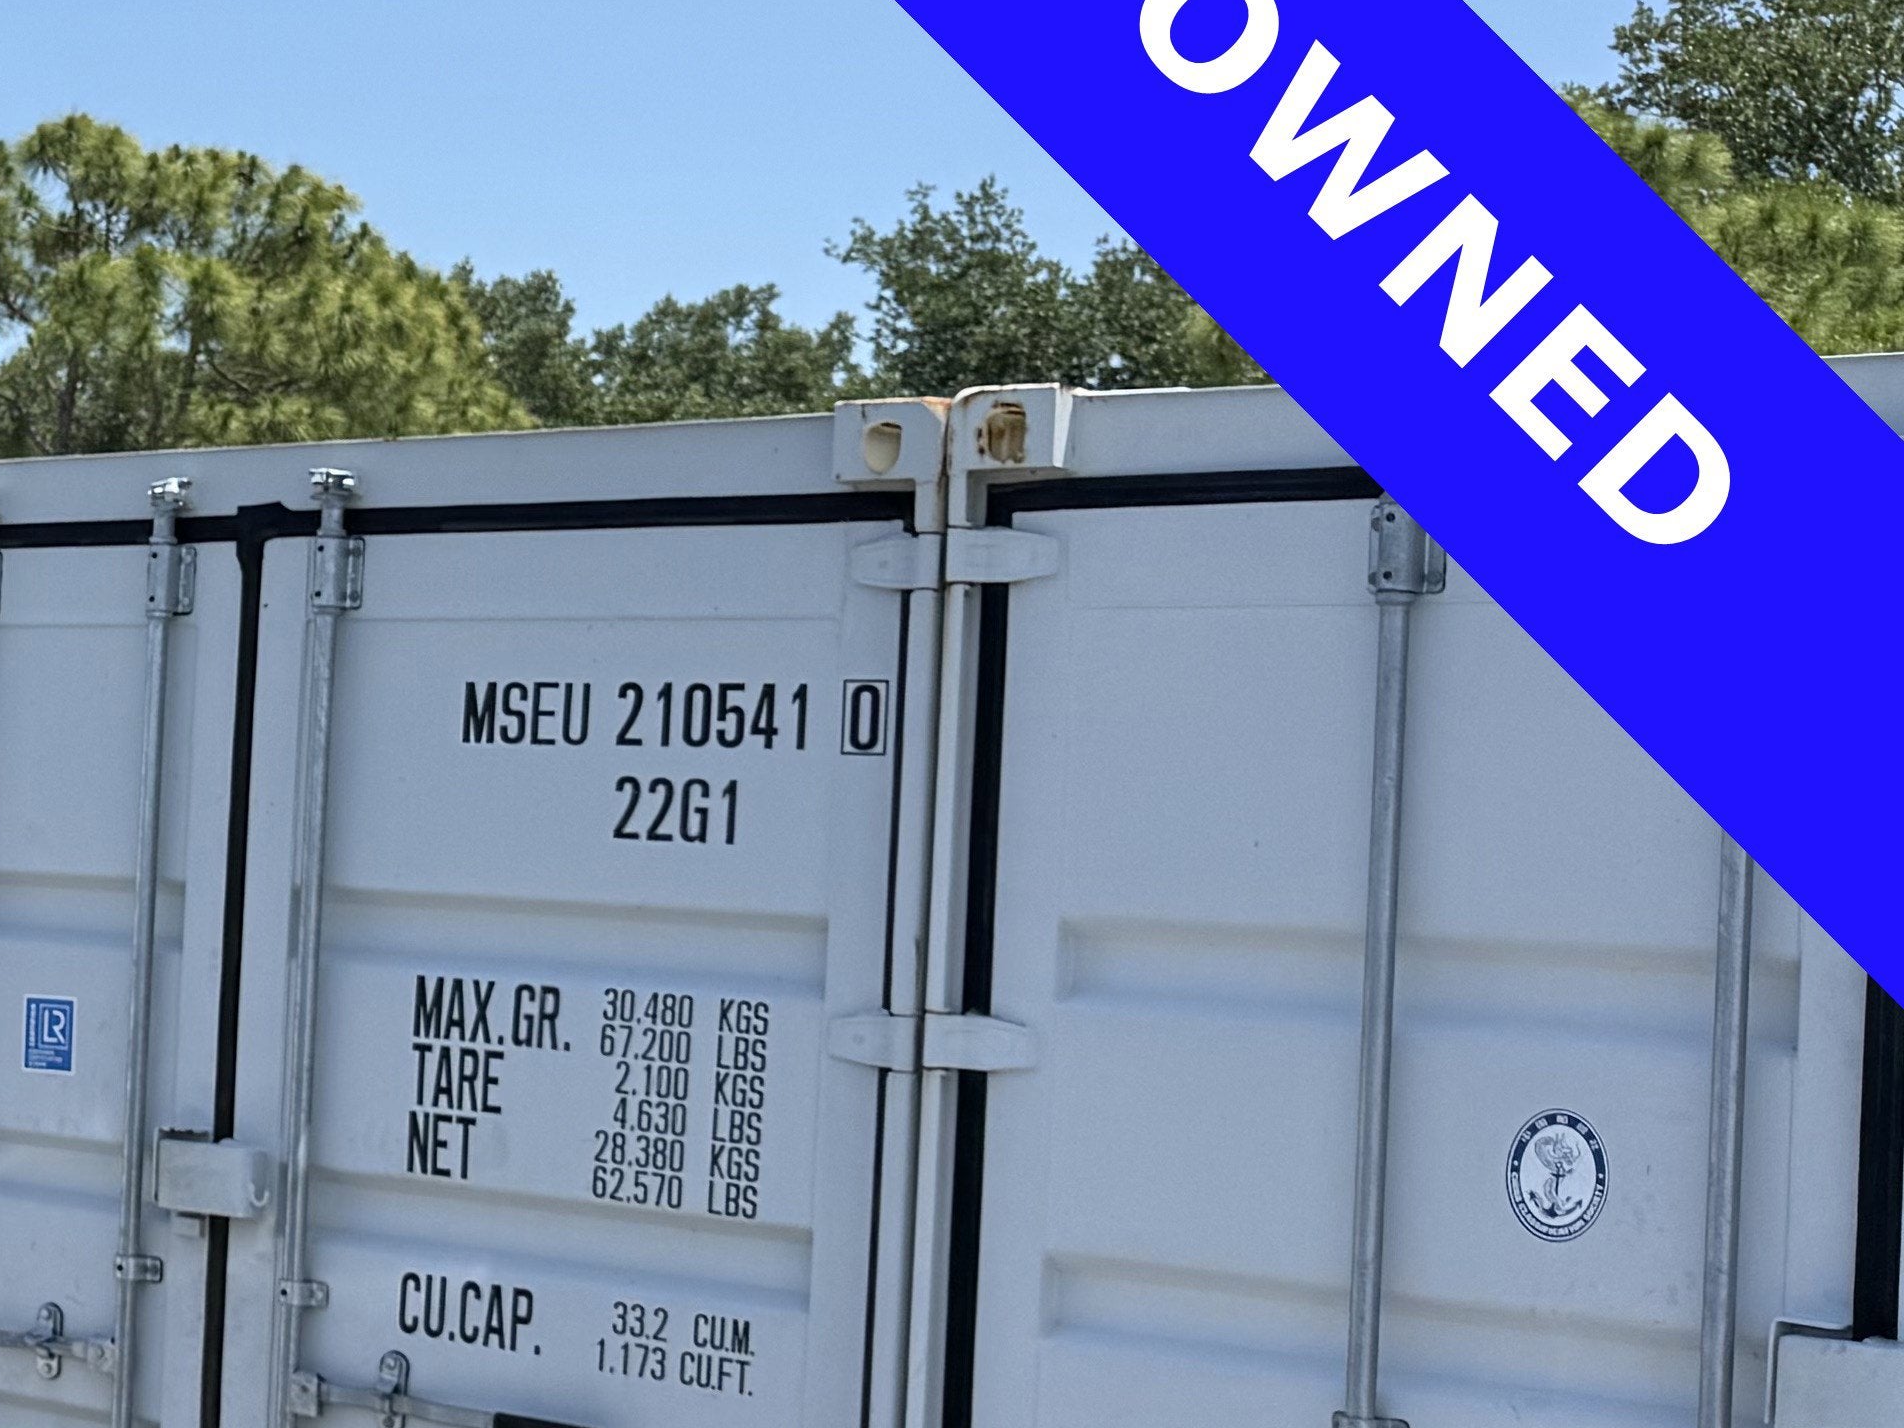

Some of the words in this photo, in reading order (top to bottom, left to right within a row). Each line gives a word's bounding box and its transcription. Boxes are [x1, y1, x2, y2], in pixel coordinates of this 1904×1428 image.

[461, 681, 592, 746] MSEU
[615, 681, 808, 751] 210541
[612, 775, 738, 846] 22G1
[412, 974, 571, 1052] MAX.GR.
[602, 987, 694, 1029] 30.480
[718, 998, 770, 1037] KGS
[599, 1023, 692, 1065] 67.200
[716, 1034, 767, 1073] LBS
[411, 1042, 505, 1115] TARE
[614, 1060, 690, 1101] 2.100
[714, 1070, 765, 1110] KGS
[406, 1110, 478, 1180] NET
[593, 1129, 685, 1173] 28.380
[709, 1143, 761, 1183] KGS
[613, 1096, 687, 1137] 4.630
[711, 1107, 763, 1147] LBS
[591, 1165, 683, 1209] 62.570
[707, 1180, 758, 1220] LBS
[398, 1271, 541, 1356] CU.CAP.
[611, 1300, 669, 1343] 33.2
[693, 1313, 755, 1357] CU.M.
[597, 1337, 667, 1382] 1.173
[679, 1350, 753, 1398] CU.FT.
